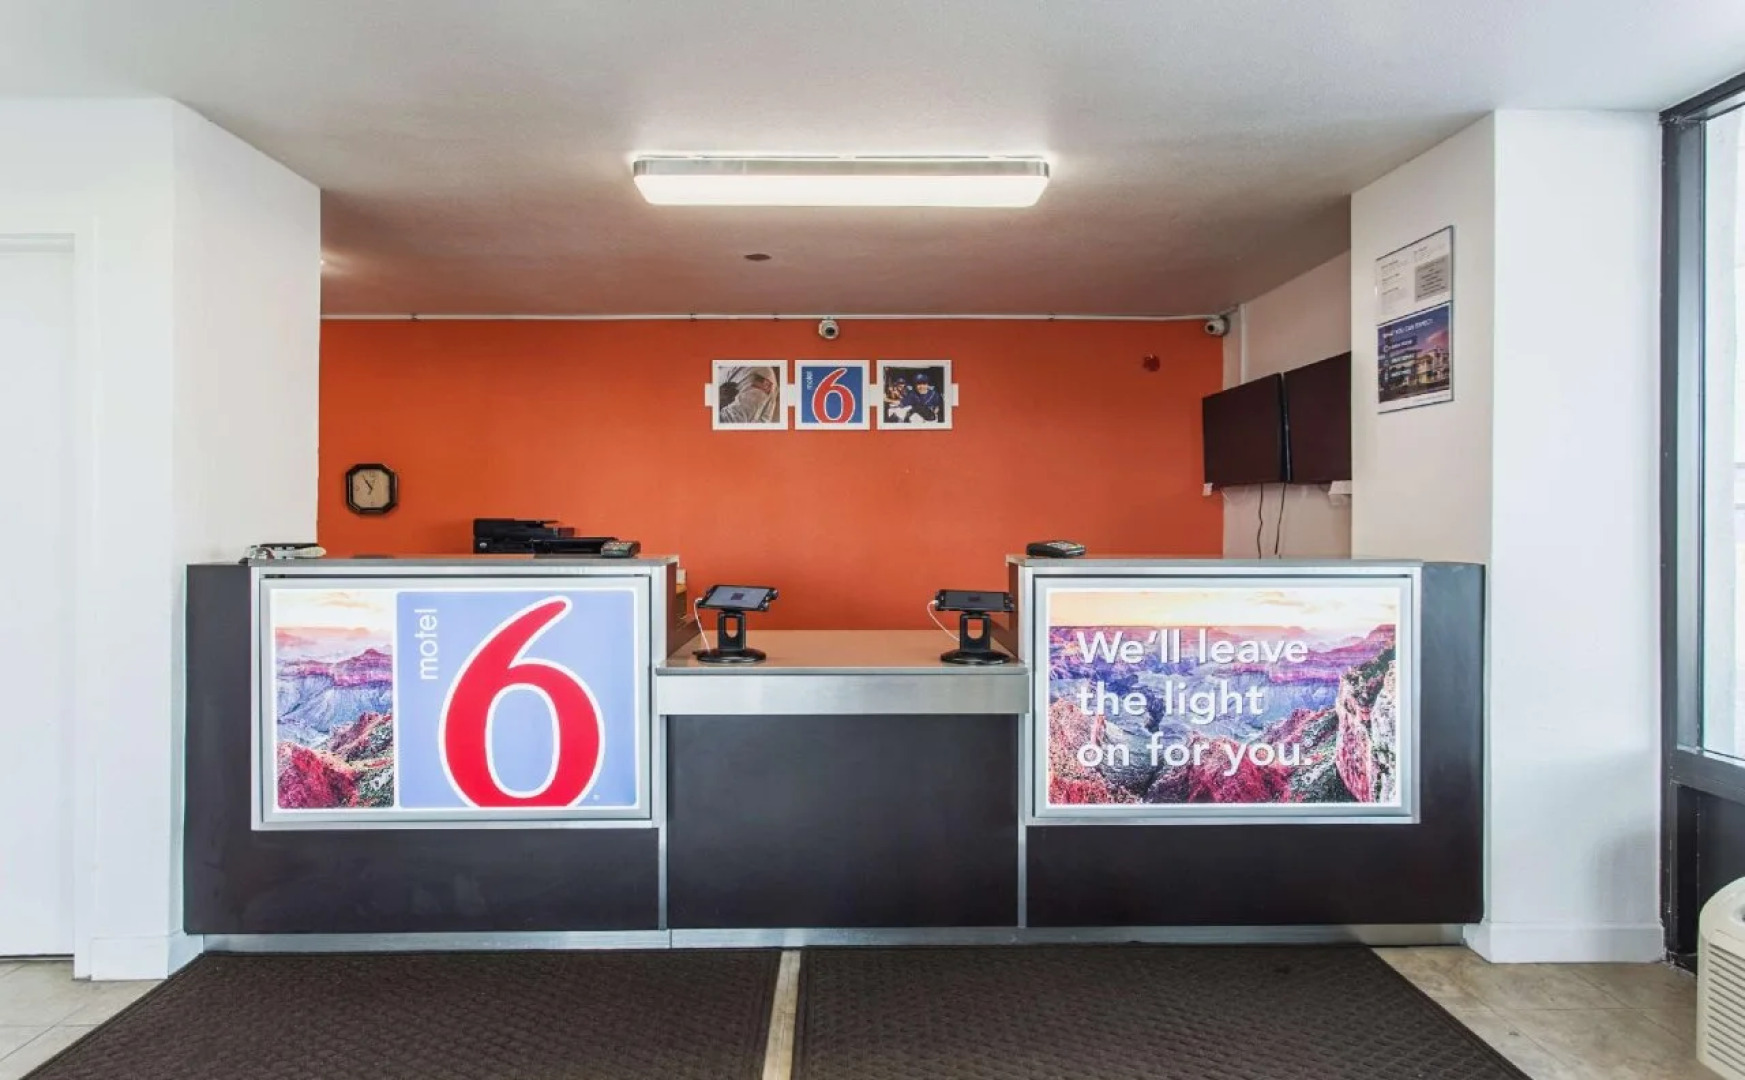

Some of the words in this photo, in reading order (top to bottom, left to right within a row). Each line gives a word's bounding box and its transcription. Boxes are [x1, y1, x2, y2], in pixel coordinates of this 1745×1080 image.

[812, 367, 856, 424] 6
[414, 608, 438, 680] motel
[1076, 629, 1182, 664] We’ll
[1199, 629, 1309, 664] leave
[438, 595, 606, 808] 6
[1077, 681, 1147, 716] the
[1165, 680, 1264, 725] light
[1076, 742, 1130, 768] on
[1147, 731, 1210, 767] for
[1223, 741, 1312, 777] you.
